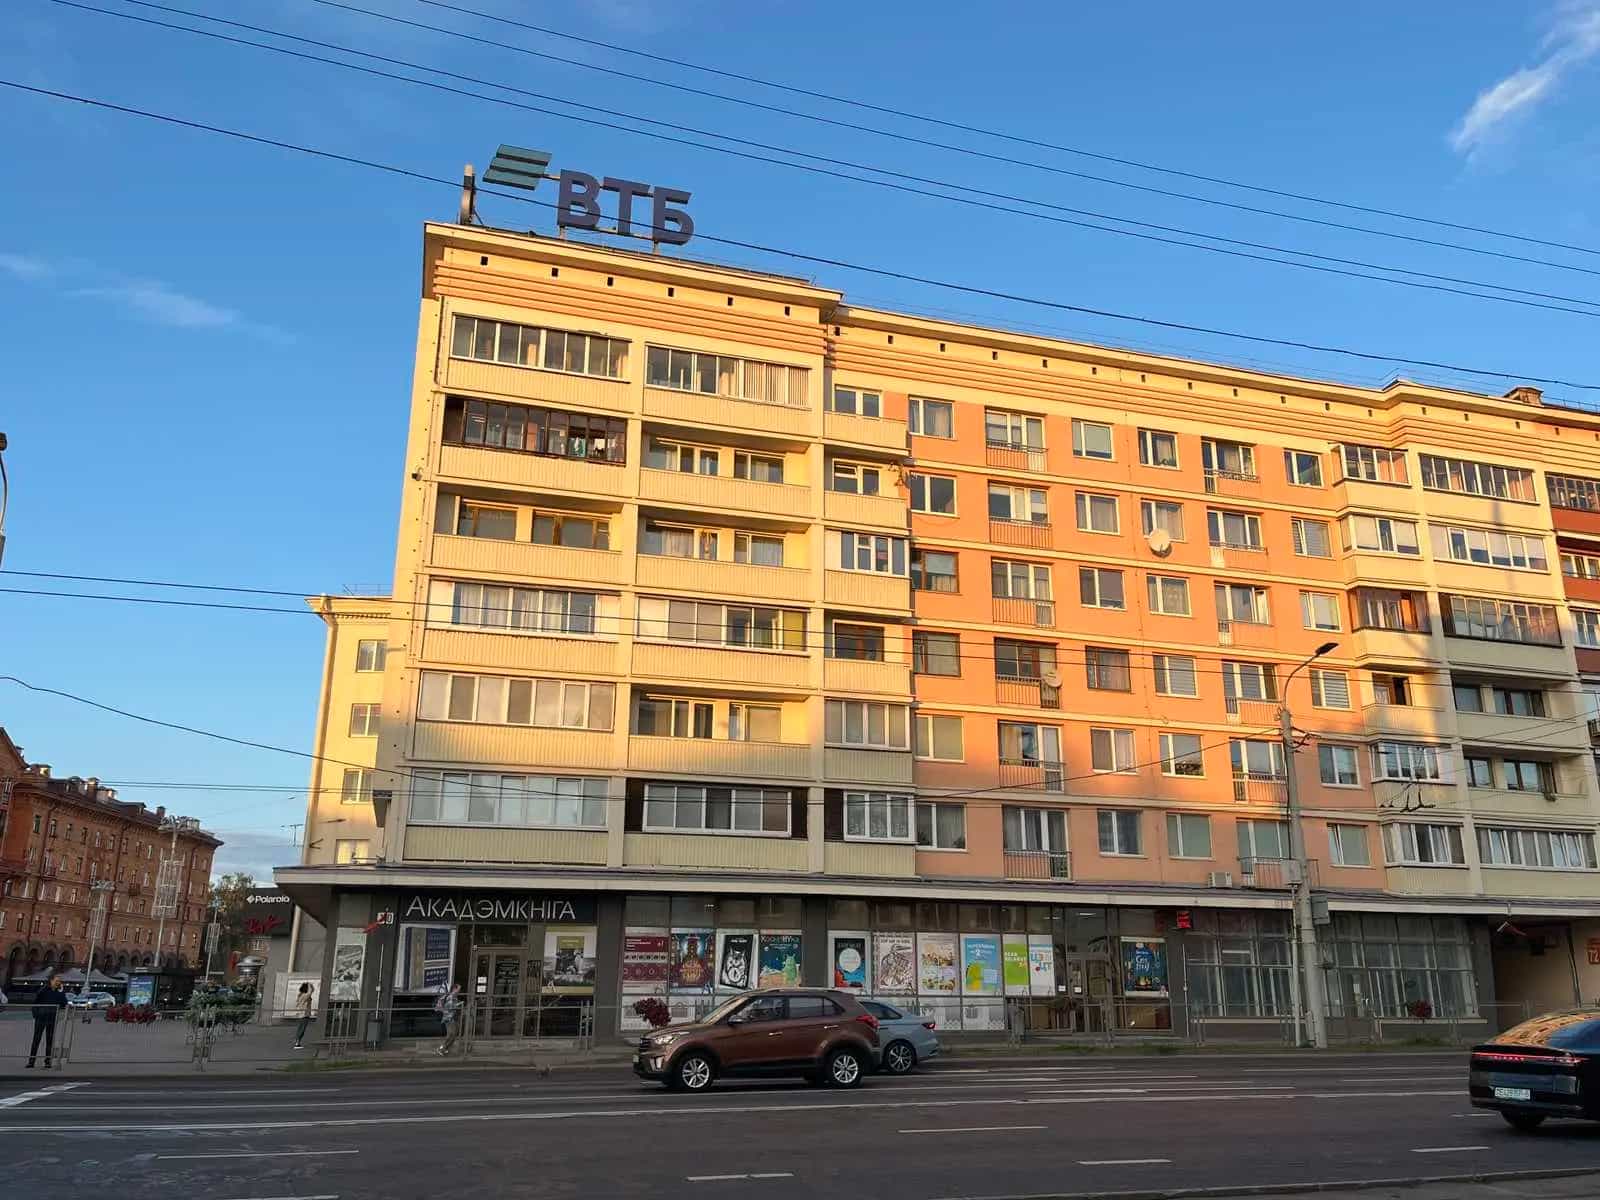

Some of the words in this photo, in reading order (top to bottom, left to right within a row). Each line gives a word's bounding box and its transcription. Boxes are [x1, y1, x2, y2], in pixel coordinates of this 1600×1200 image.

[558, 168, 695, 246] ВТБ
[255, 895, 290, 904] Polaroid
[406, 895, 576, 920] АКАДЭМКНІГА
